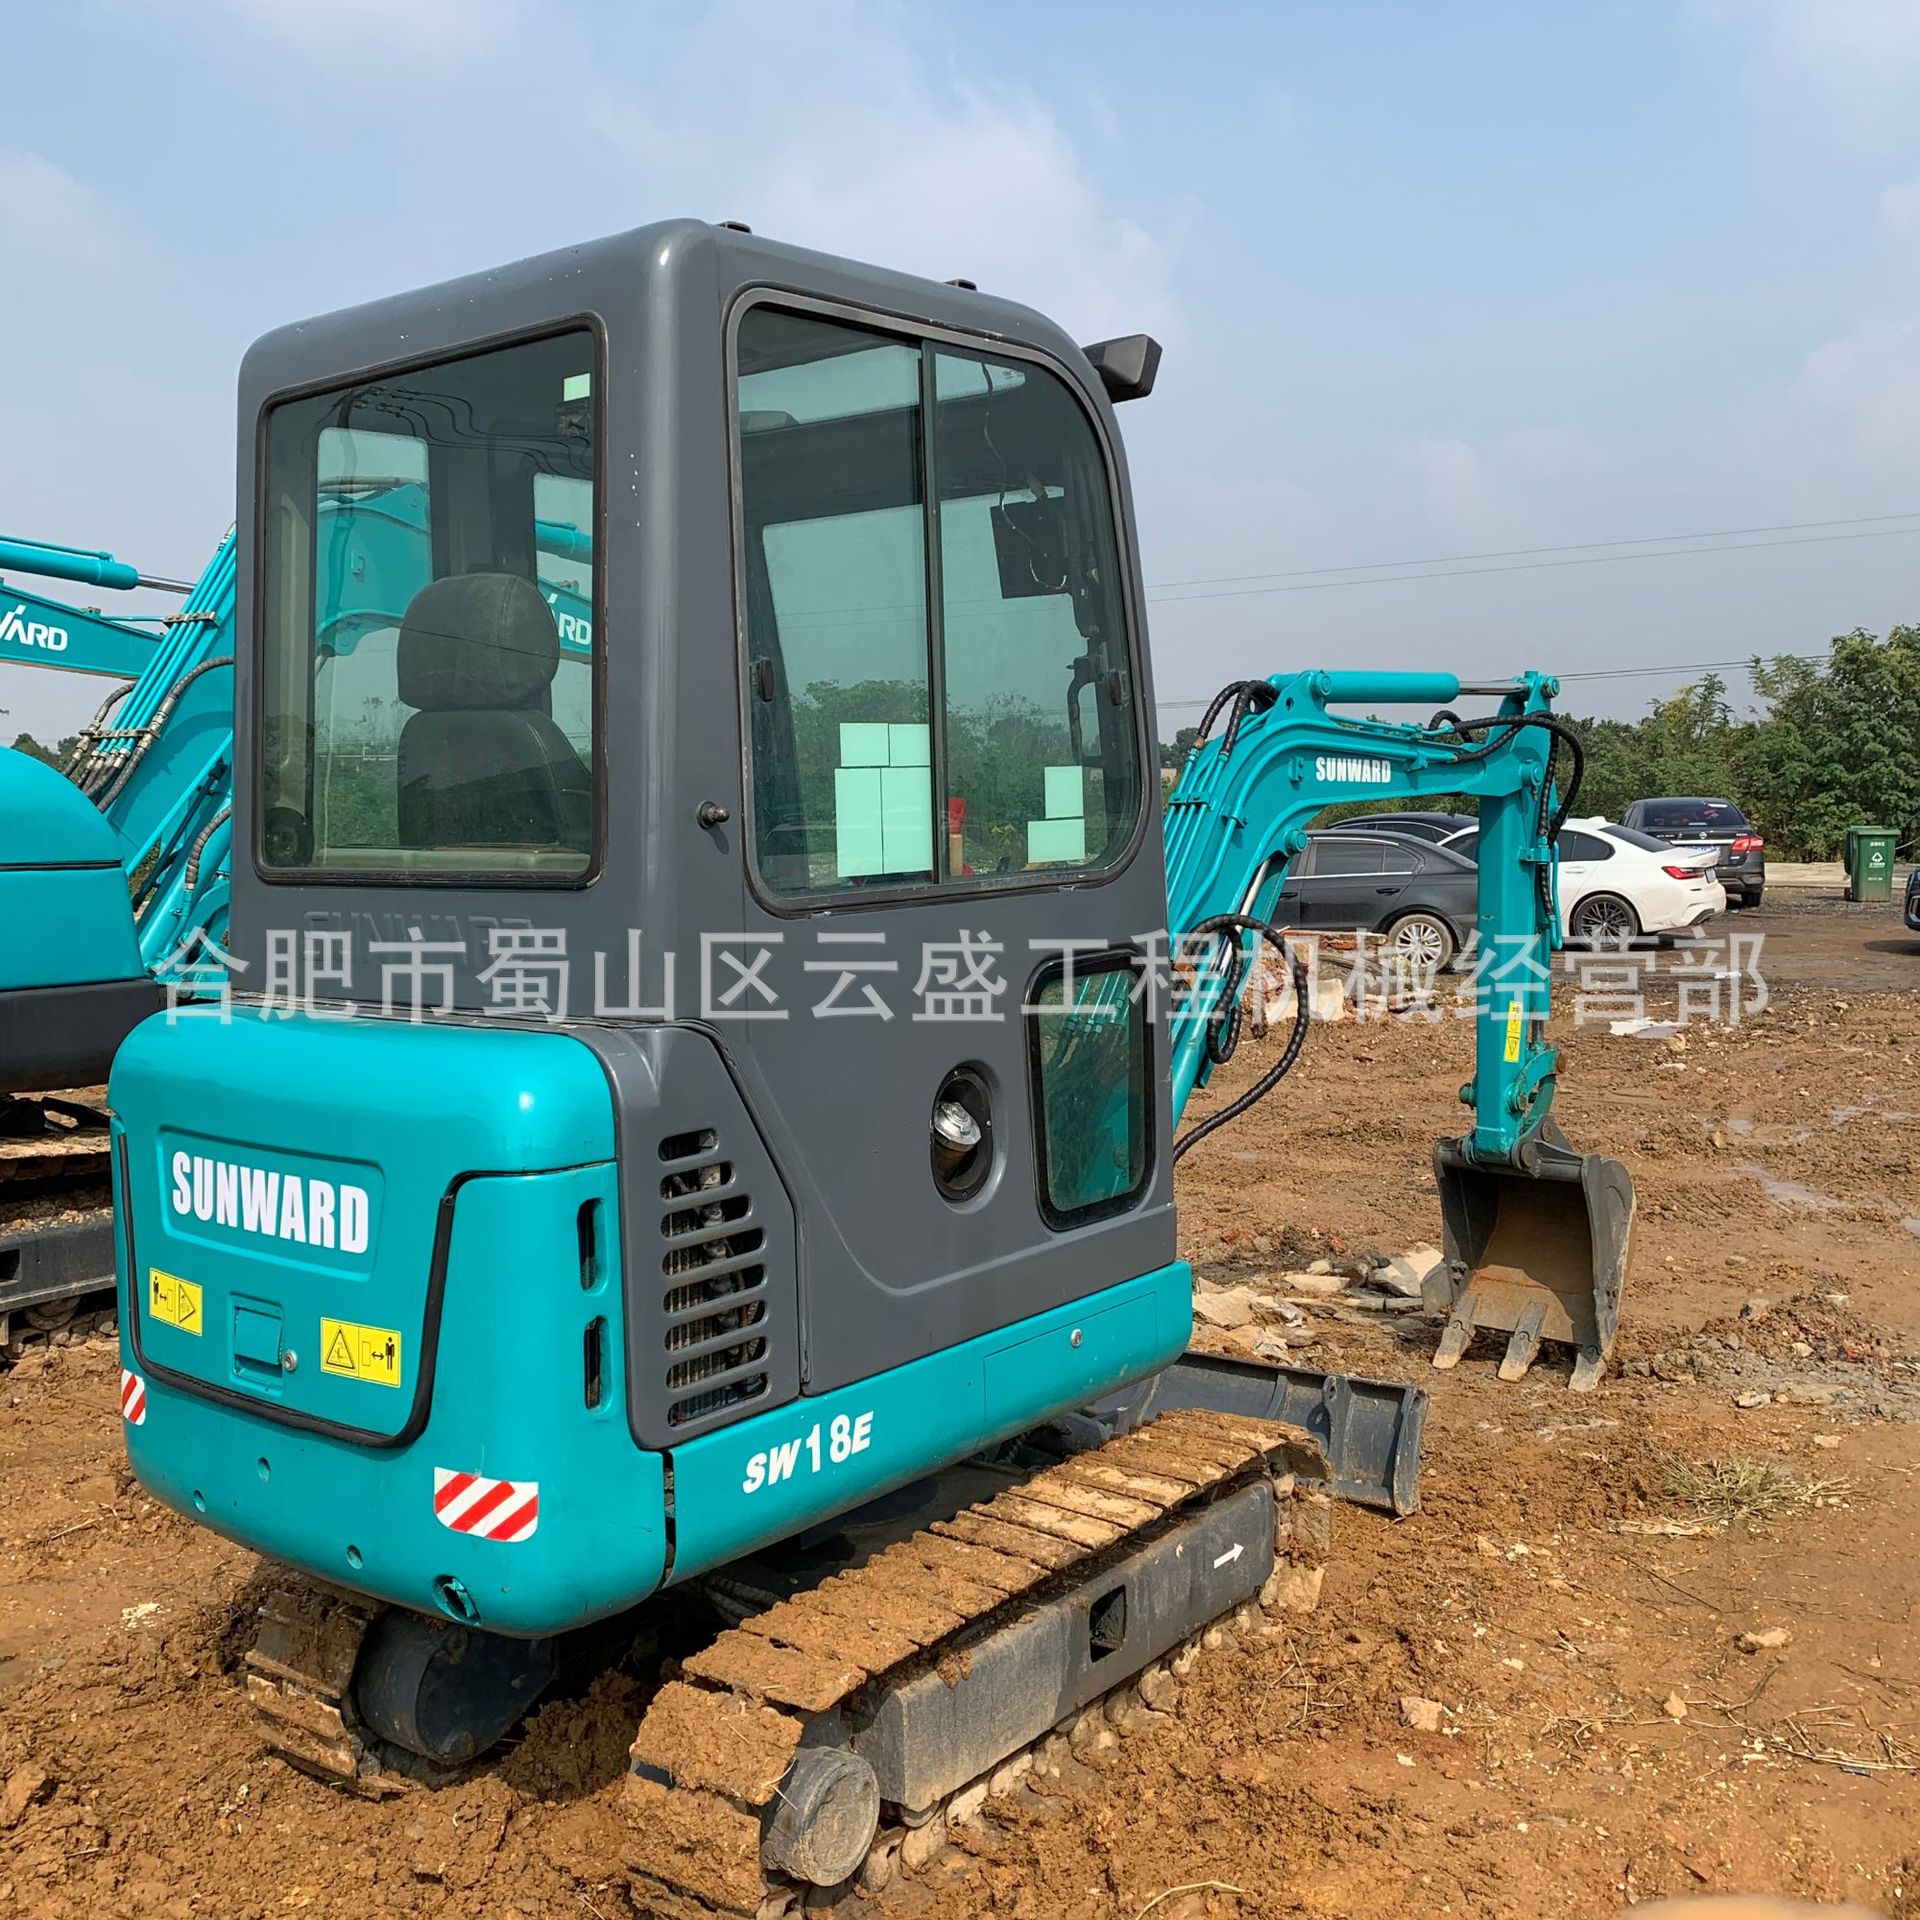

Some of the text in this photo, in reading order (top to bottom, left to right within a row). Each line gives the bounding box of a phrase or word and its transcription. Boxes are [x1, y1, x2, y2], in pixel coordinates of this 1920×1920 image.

[1315, 756, 1391, 783] SUNWARD
[172, 1151, 368, 1254] SUNWARD
[742, 1410, 874, 1494] SW18E
